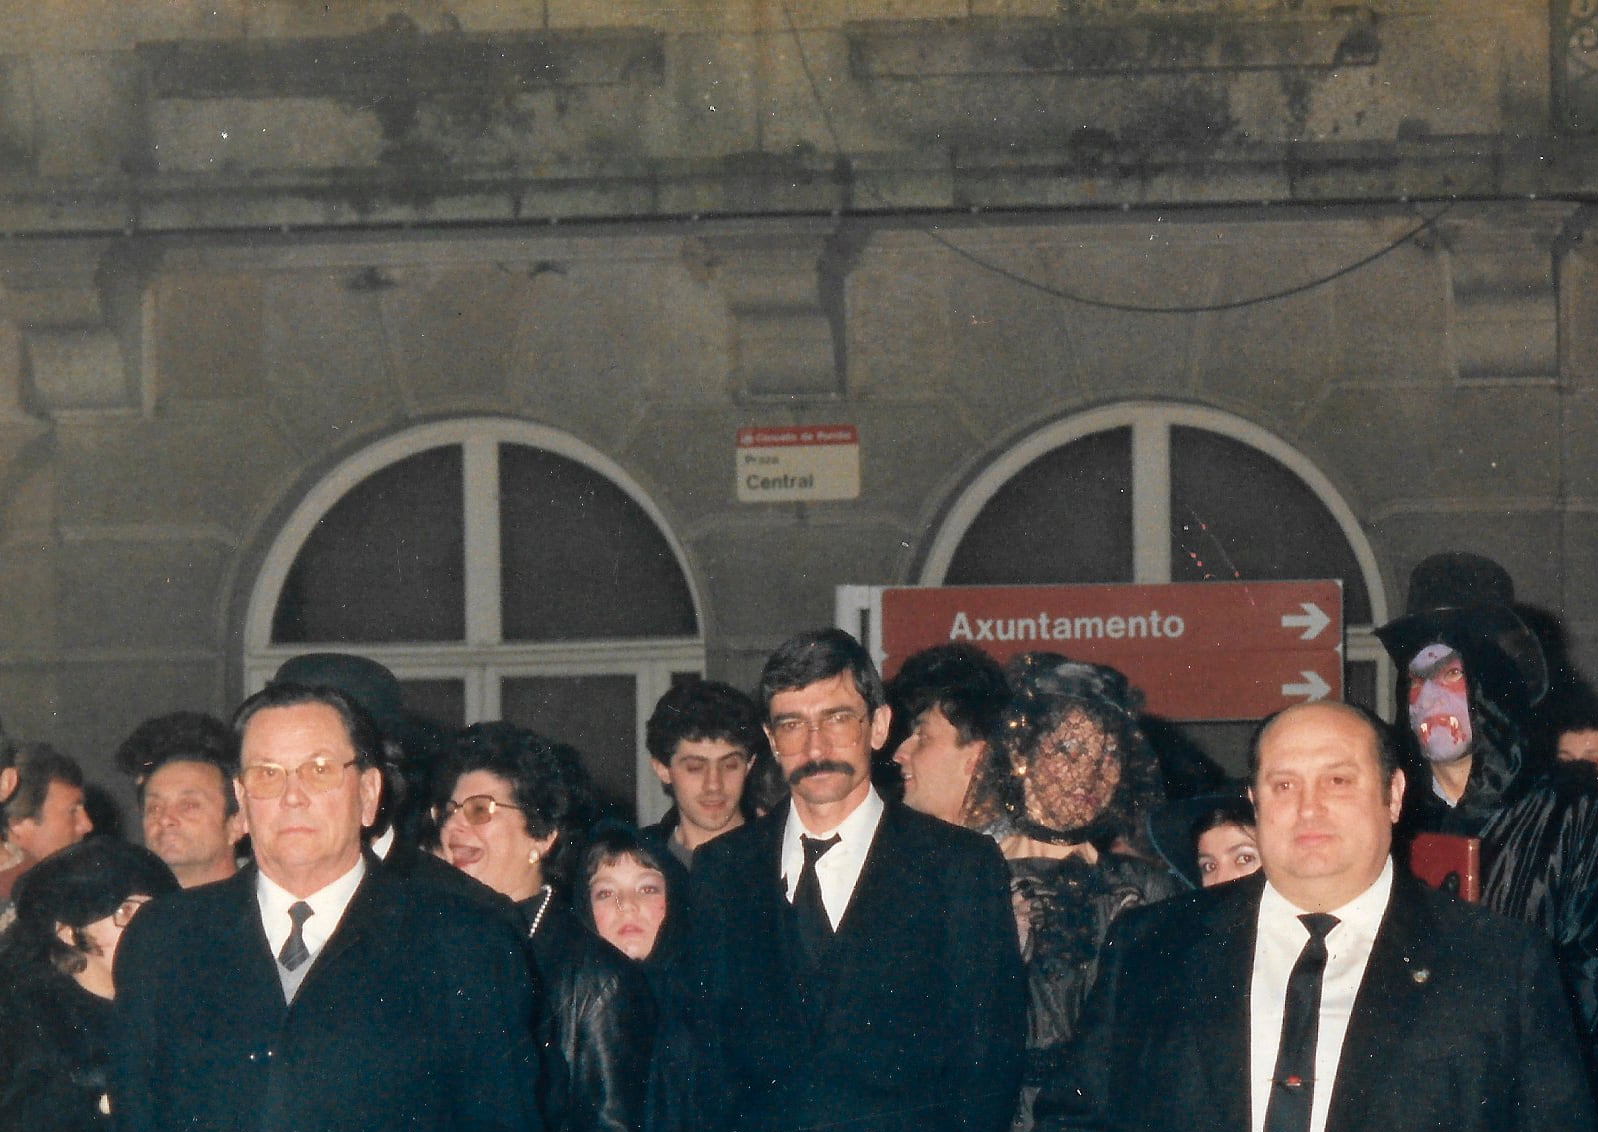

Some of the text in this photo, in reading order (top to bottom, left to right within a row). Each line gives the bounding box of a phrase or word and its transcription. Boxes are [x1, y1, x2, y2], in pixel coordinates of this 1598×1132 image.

[744, 455, 780, 465] Praza
[746, 473, 814, 490] Central
[950, 610, 1185, 641] Axuntamento
